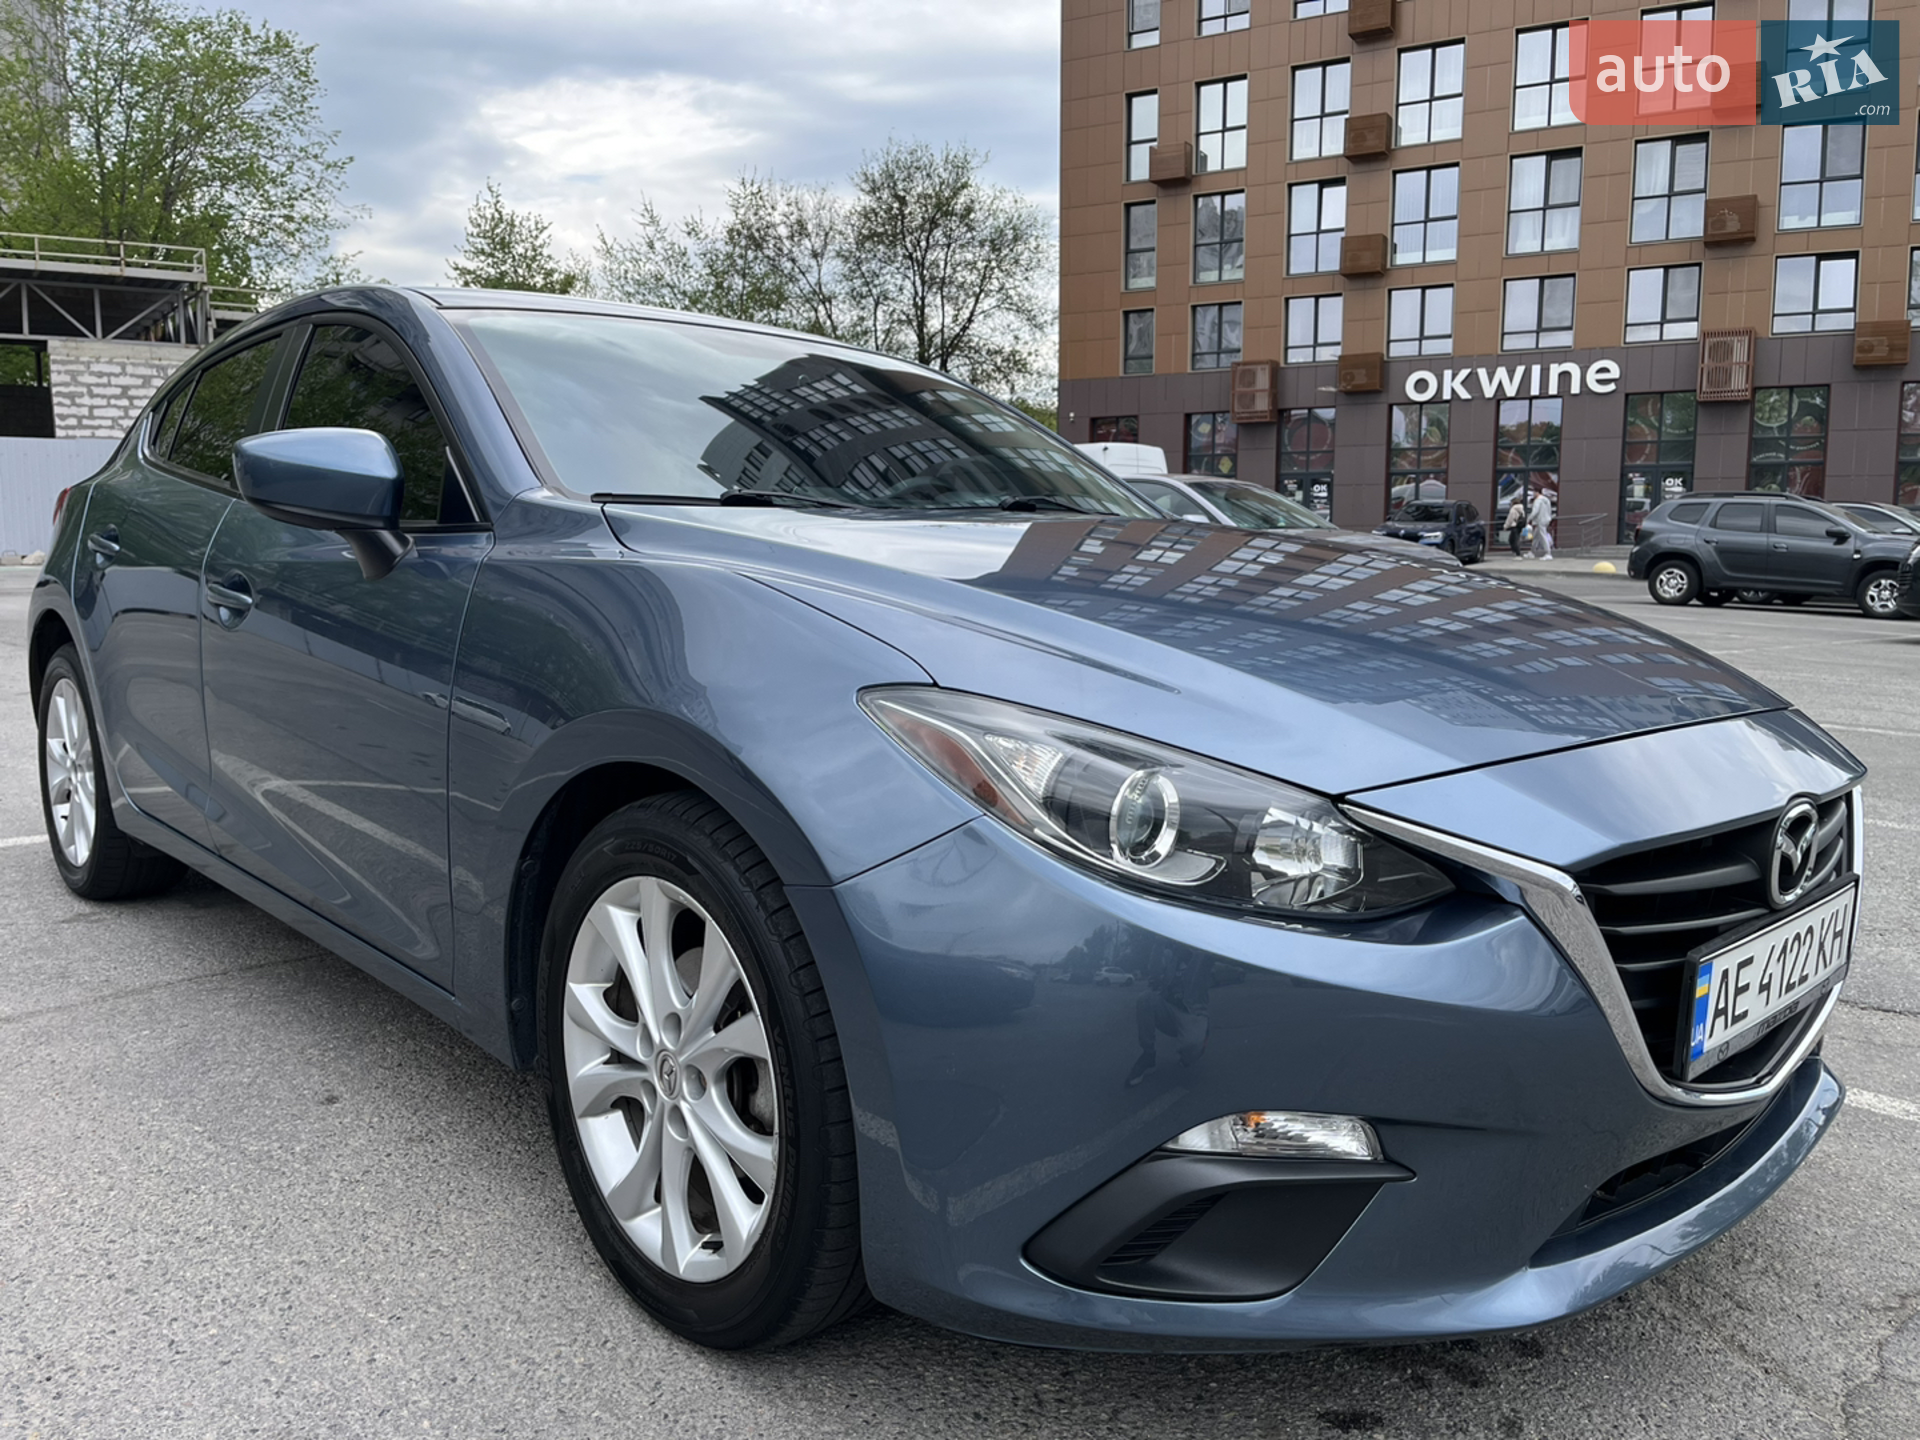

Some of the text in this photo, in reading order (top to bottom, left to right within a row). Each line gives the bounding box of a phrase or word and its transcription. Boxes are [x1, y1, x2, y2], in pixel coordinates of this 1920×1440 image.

[1312, 483, 1328, 493] OK
[1665, 476, 1684, 487] OK
[624, 841, 678, 861] 225/50R17
[1708, 903, 1849, 1040] AE 4122 KH
[1691, 1023, 1705, 1047] UA
